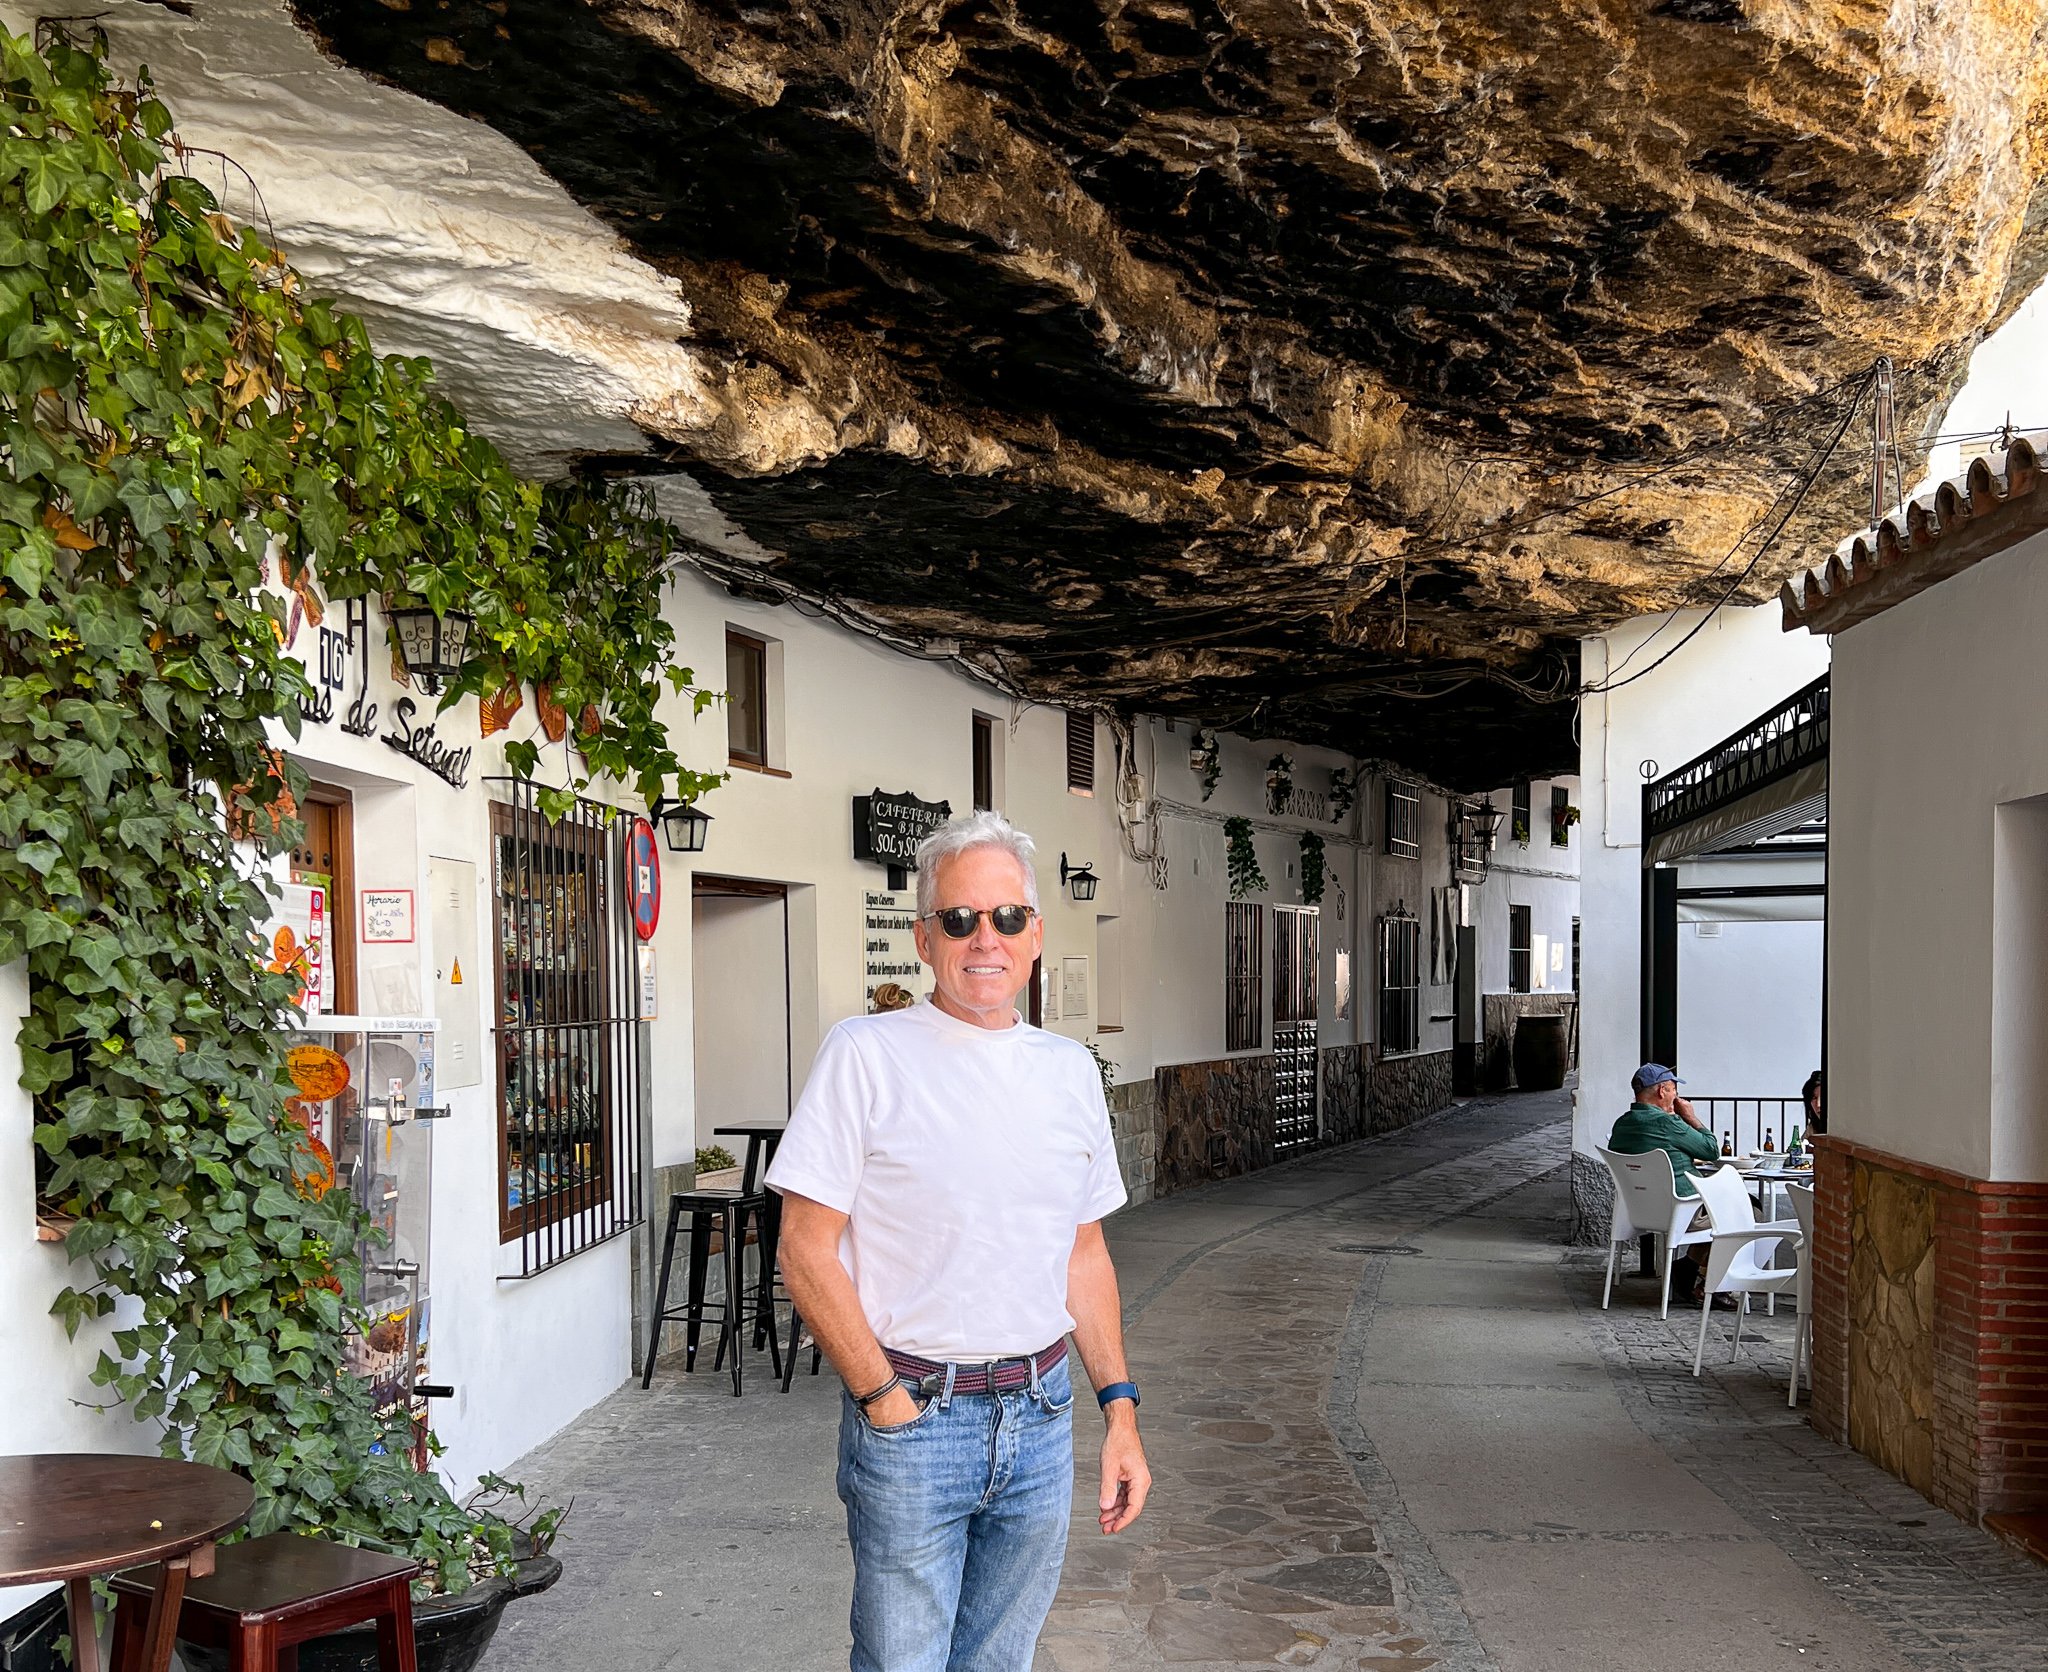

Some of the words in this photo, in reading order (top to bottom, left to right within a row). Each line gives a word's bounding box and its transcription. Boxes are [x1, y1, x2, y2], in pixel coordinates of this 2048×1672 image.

[321, 633, 344, 683] 16
[349, 684, 378, 738] de
[876, 801, 944, 827] CAFETERIA
[898, 820, 924, 838] BAR
[876, 833, 897, 853] SOL
[897, 840, 904, 858] y
[366, 894, 402, 908] Horario
